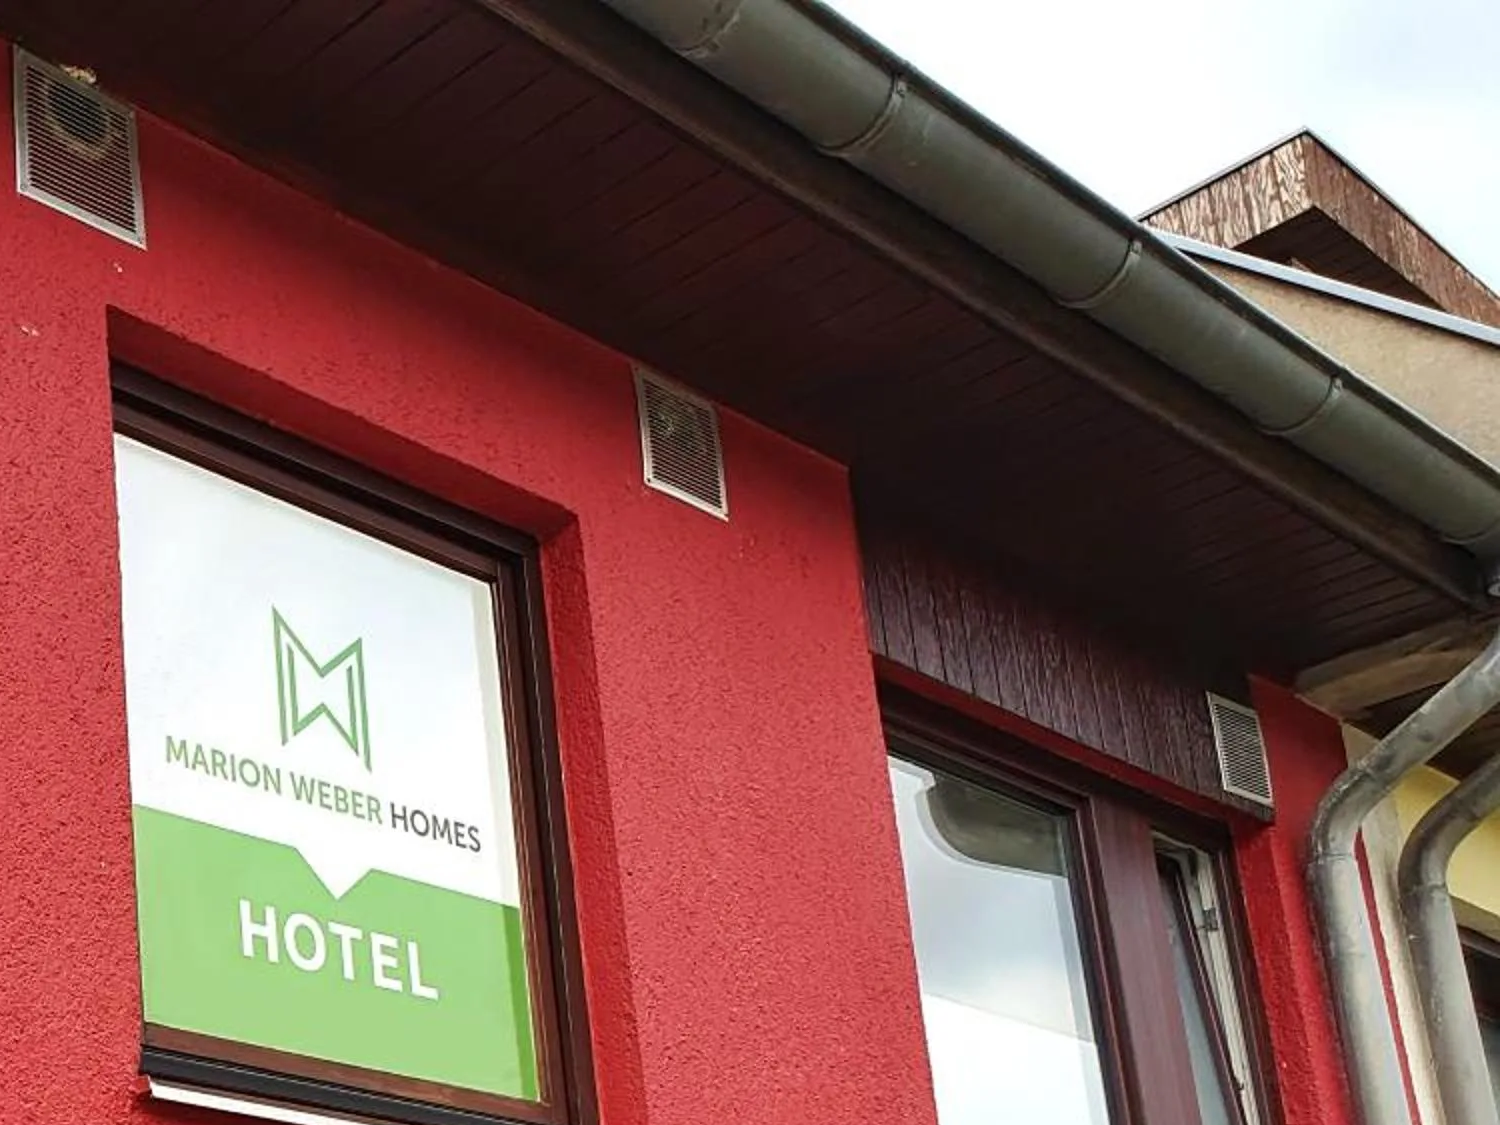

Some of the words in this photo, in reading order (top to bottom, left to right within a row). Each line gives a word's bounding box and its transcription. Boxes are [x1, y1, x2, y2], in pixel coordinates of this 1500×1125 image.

[165, 735, 283, 796] MARION
[289, 771, 384, 826] WEBER
[389, 802, 482, 853] HOMES
[238, 898, 440, 1001] HOTEL
